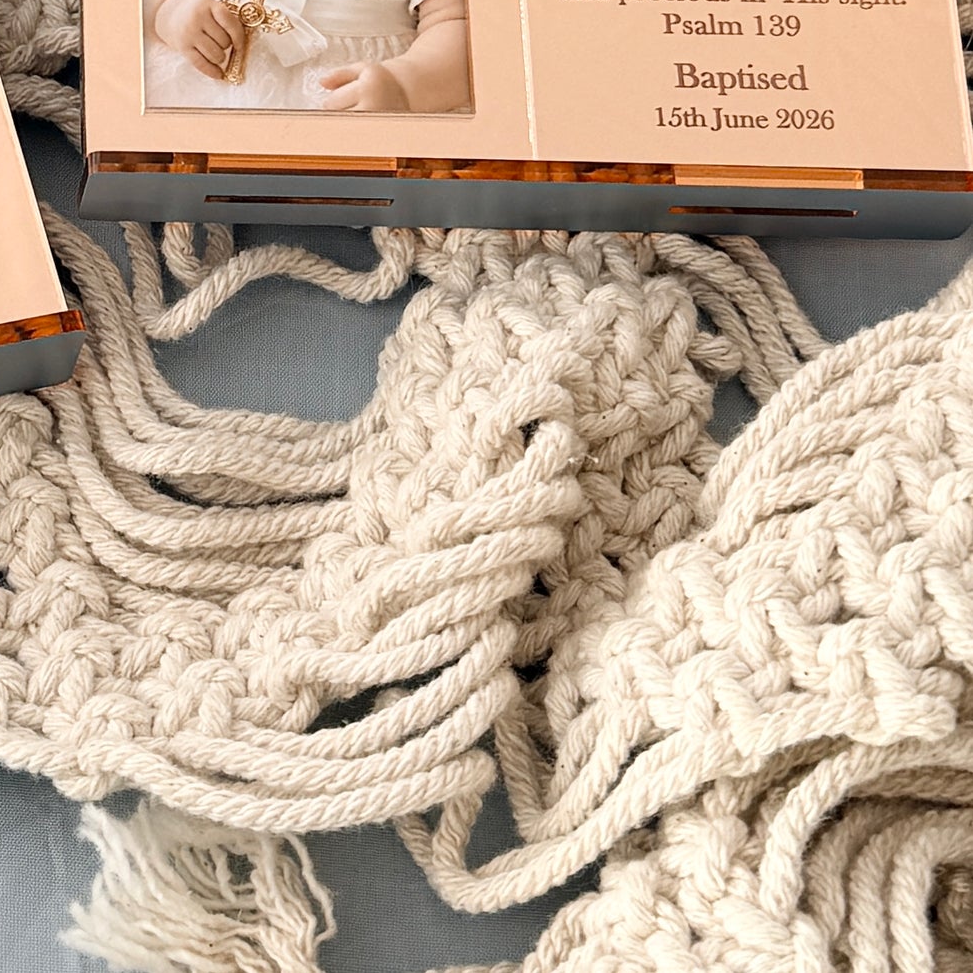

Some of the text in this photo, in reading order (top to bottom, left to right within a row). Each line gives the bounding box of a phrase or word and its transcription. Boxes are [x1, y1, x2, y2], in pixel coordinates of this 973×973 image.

[662, 13, 801, 37] Psalm 139
[673, 63, 808, 96] Baptised
[776, 109, 835, 130] 2026
